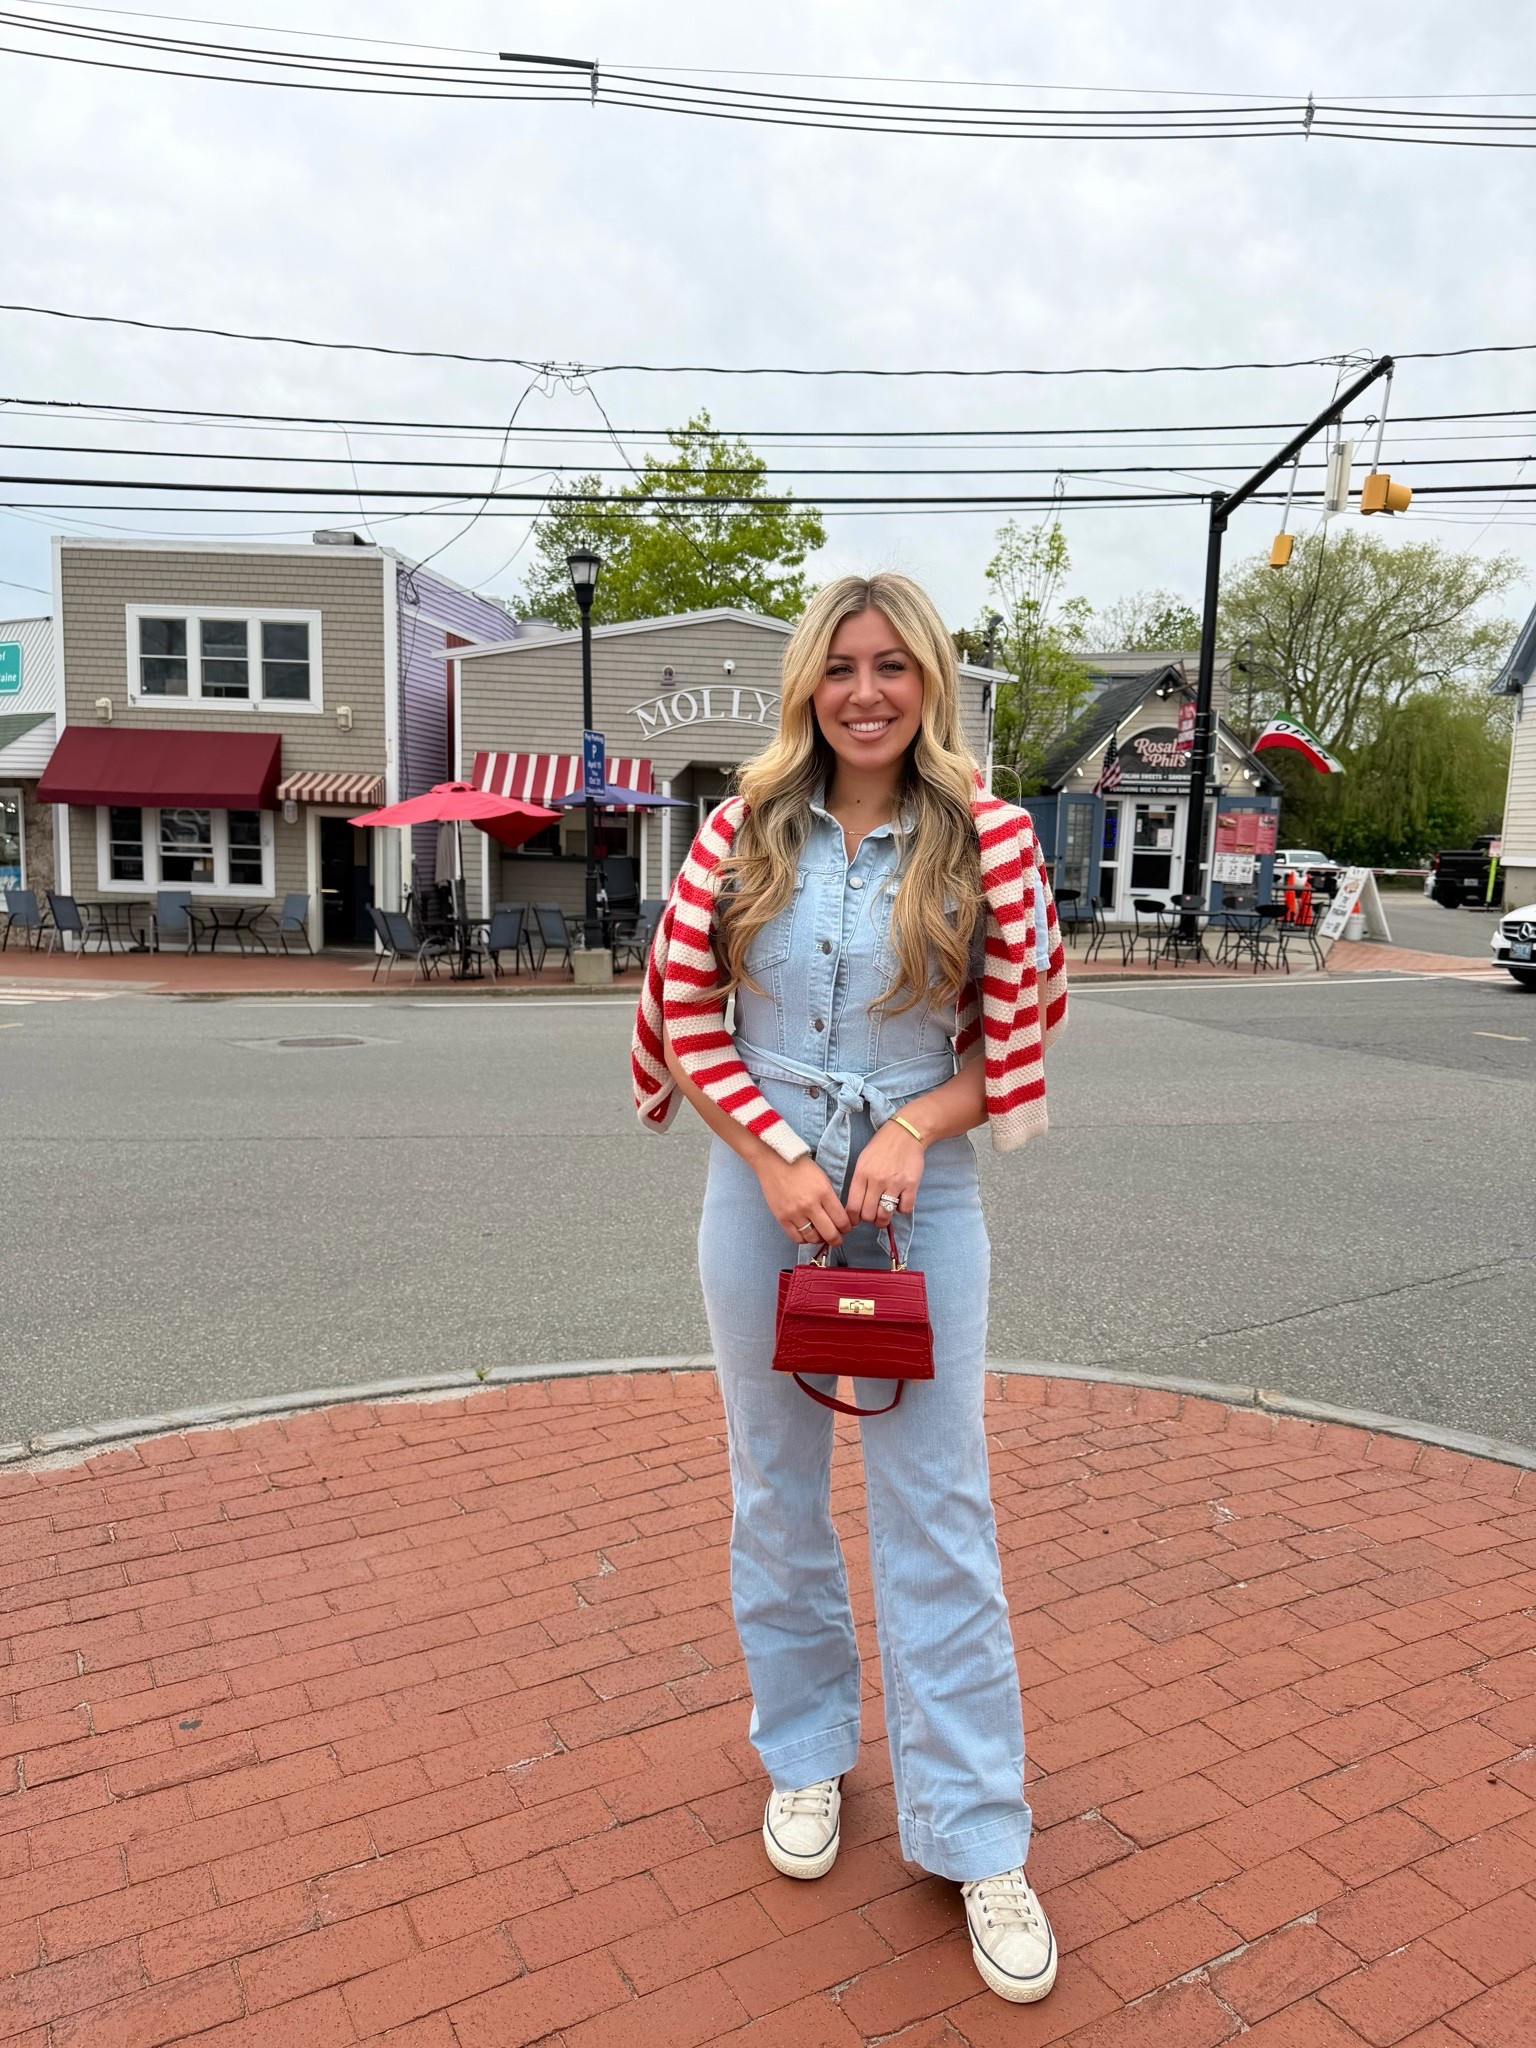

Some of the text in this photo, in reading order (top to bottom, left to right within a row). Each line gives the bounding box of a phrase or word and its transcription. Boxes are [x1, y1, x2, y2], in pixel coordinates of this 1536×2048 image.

[0, 672, 17, 682] aine
[1133, 738, 1185, 756] Rosal
[1275, 723, 1330, 760] OPEN
[592, 744, 598, 759] P
